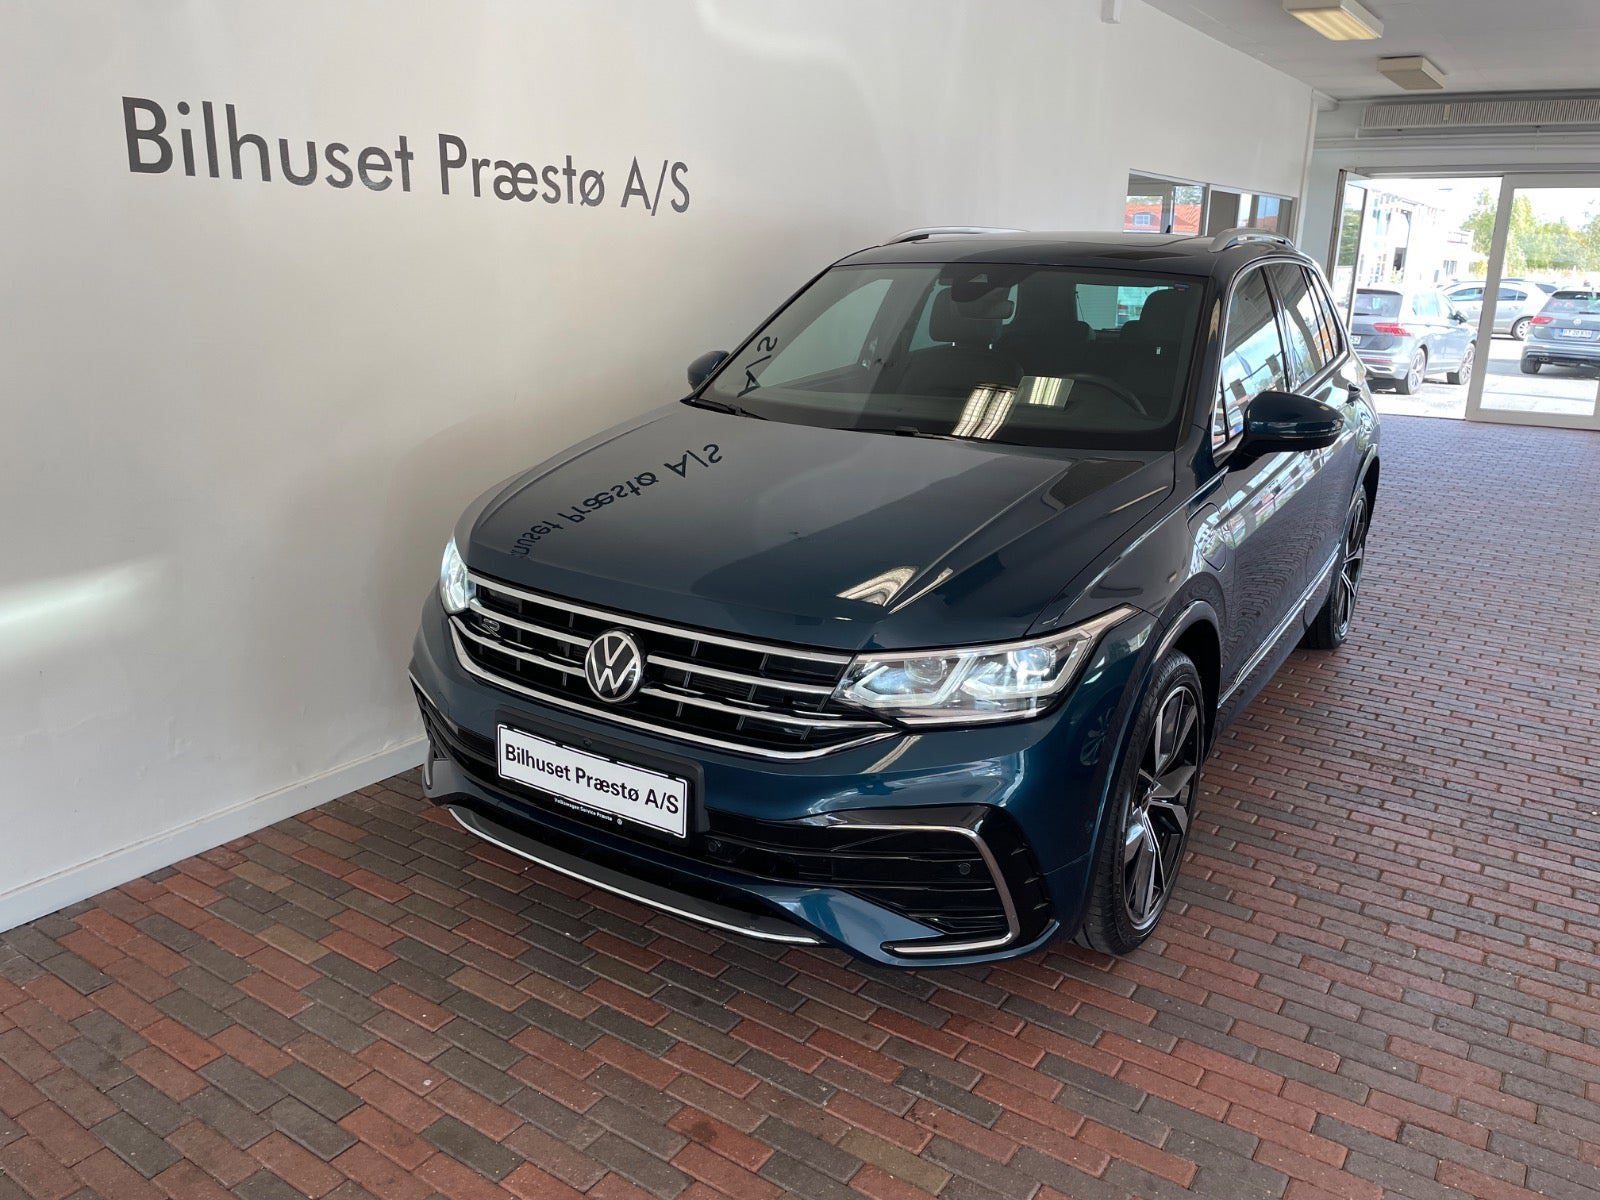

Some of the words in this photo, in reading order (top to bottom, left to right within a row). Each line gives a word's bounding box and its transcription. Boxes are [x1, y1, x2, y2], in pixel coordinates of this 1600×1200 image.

[122, 96, 414, 192] Bilhuset
[438, 133, 605, 207] Præstø
[620, 156, 691, 217] A/S
[505, 743, 571, 782] Bilhuset
[575, 766, 640, 802] Præstø
[645, 788, 679, 815] A/S
